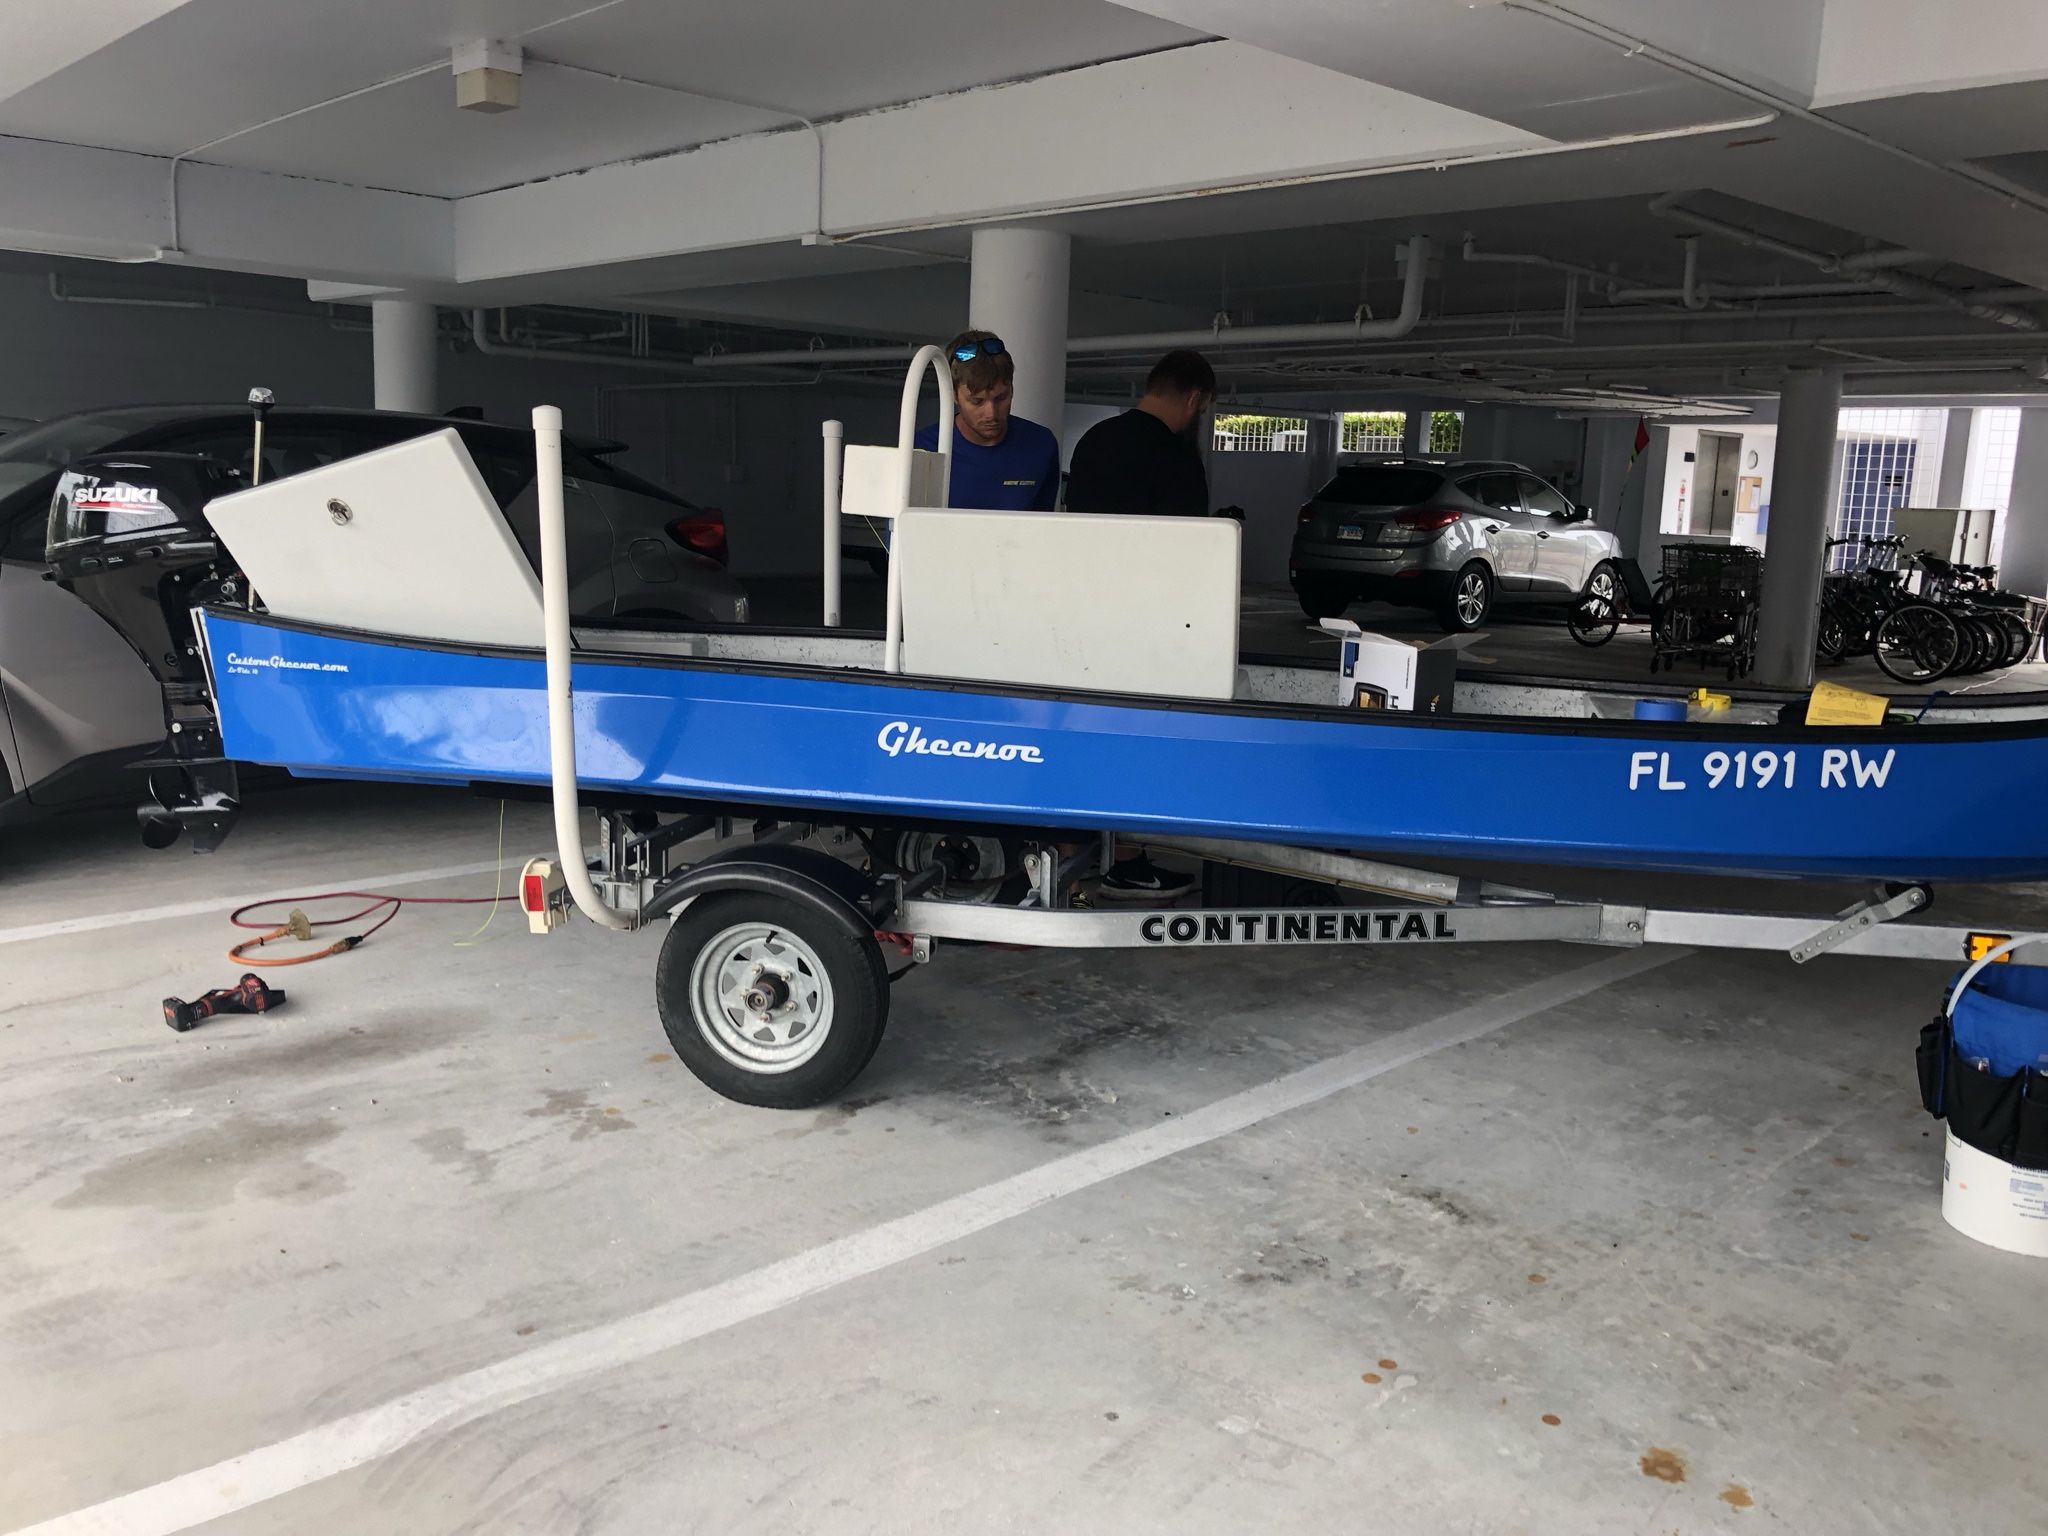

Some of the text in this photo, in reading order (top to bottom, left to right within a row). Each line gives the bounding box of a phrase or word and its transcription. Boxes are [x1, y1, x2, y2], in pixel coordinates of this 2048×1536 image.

[74, 487, 158, 504] SUZUKI
[877, 721, 1045, 763] Gheenoe
[1629, 749, 1896, 790] FL 9191 RW
[1140, 911, 1457, 944] CONTINENTAL
